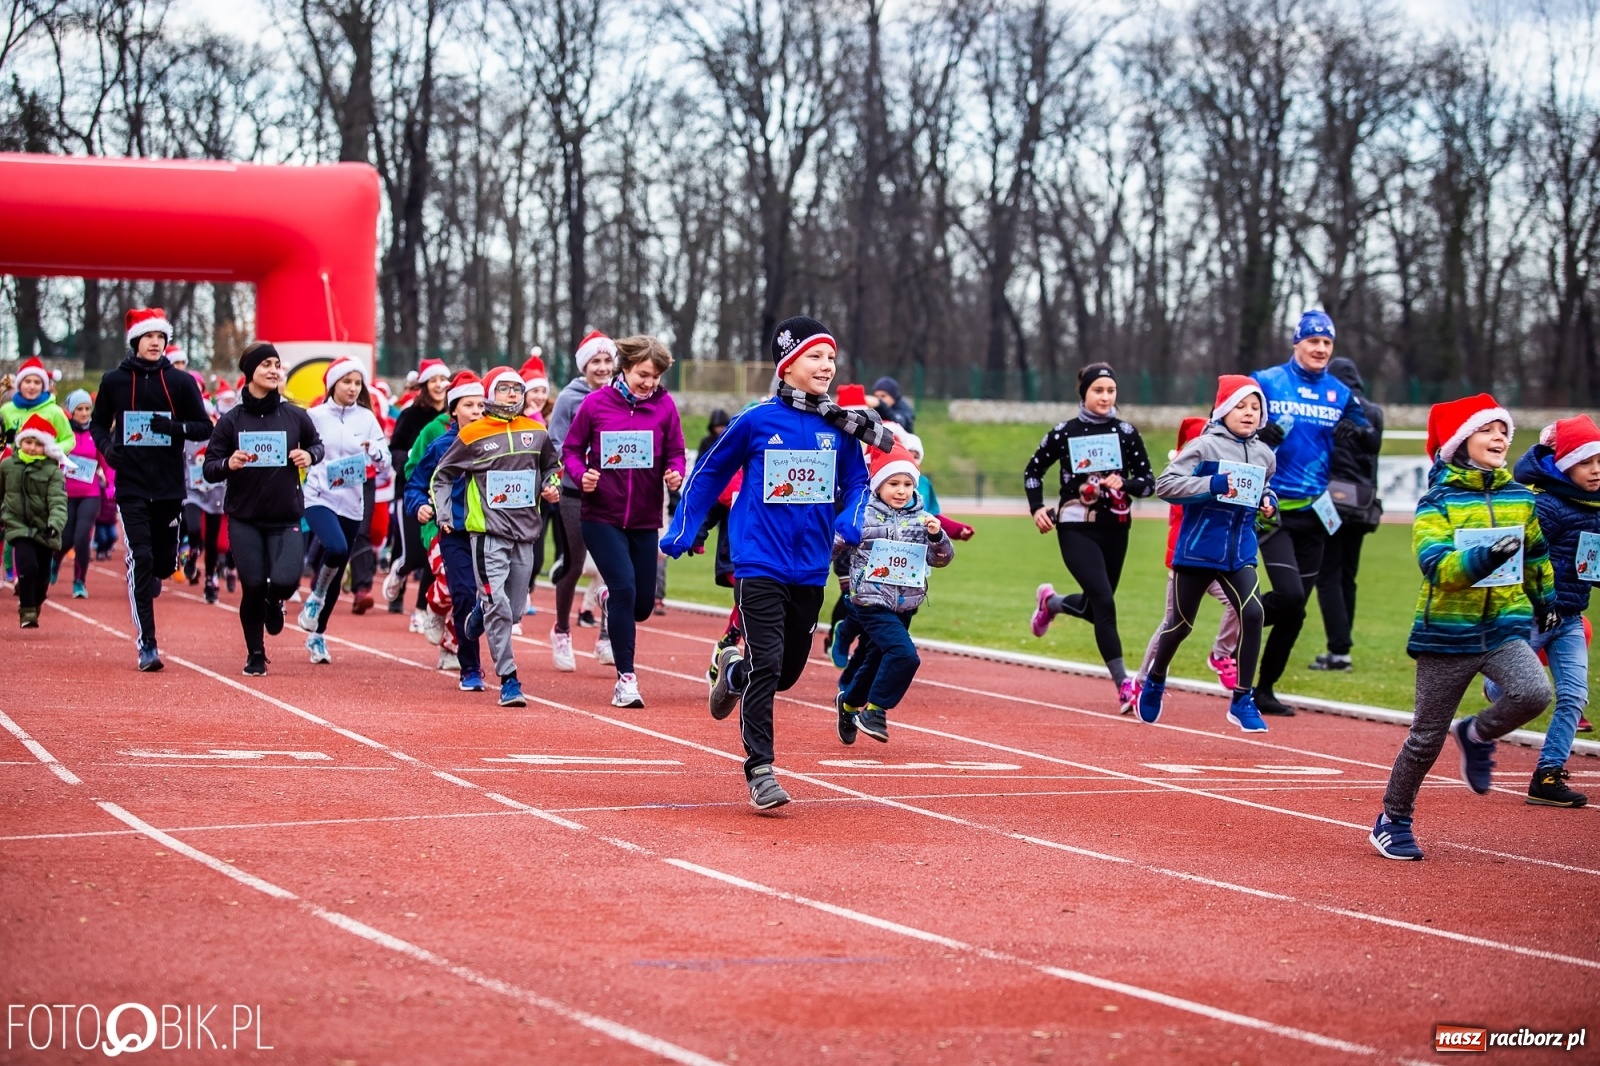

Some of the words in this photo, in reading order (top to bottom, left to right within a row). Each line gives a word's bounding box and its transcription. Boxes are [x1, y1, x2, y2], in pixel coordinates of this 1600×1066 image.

[1269, 400, 1342, 421] RUNNERS
[254, 443, 273, 453] 009
[617, 443, 638, 454] 203
[1087, 447, 1104, 458] 167
[340, 466, 355, 477] 143
[787, 468, 816, 482] 032
[504, 483, 522, 493] 210
[1236, 477, 1253, 490] 159
[888, 555, 908, 568] 199
